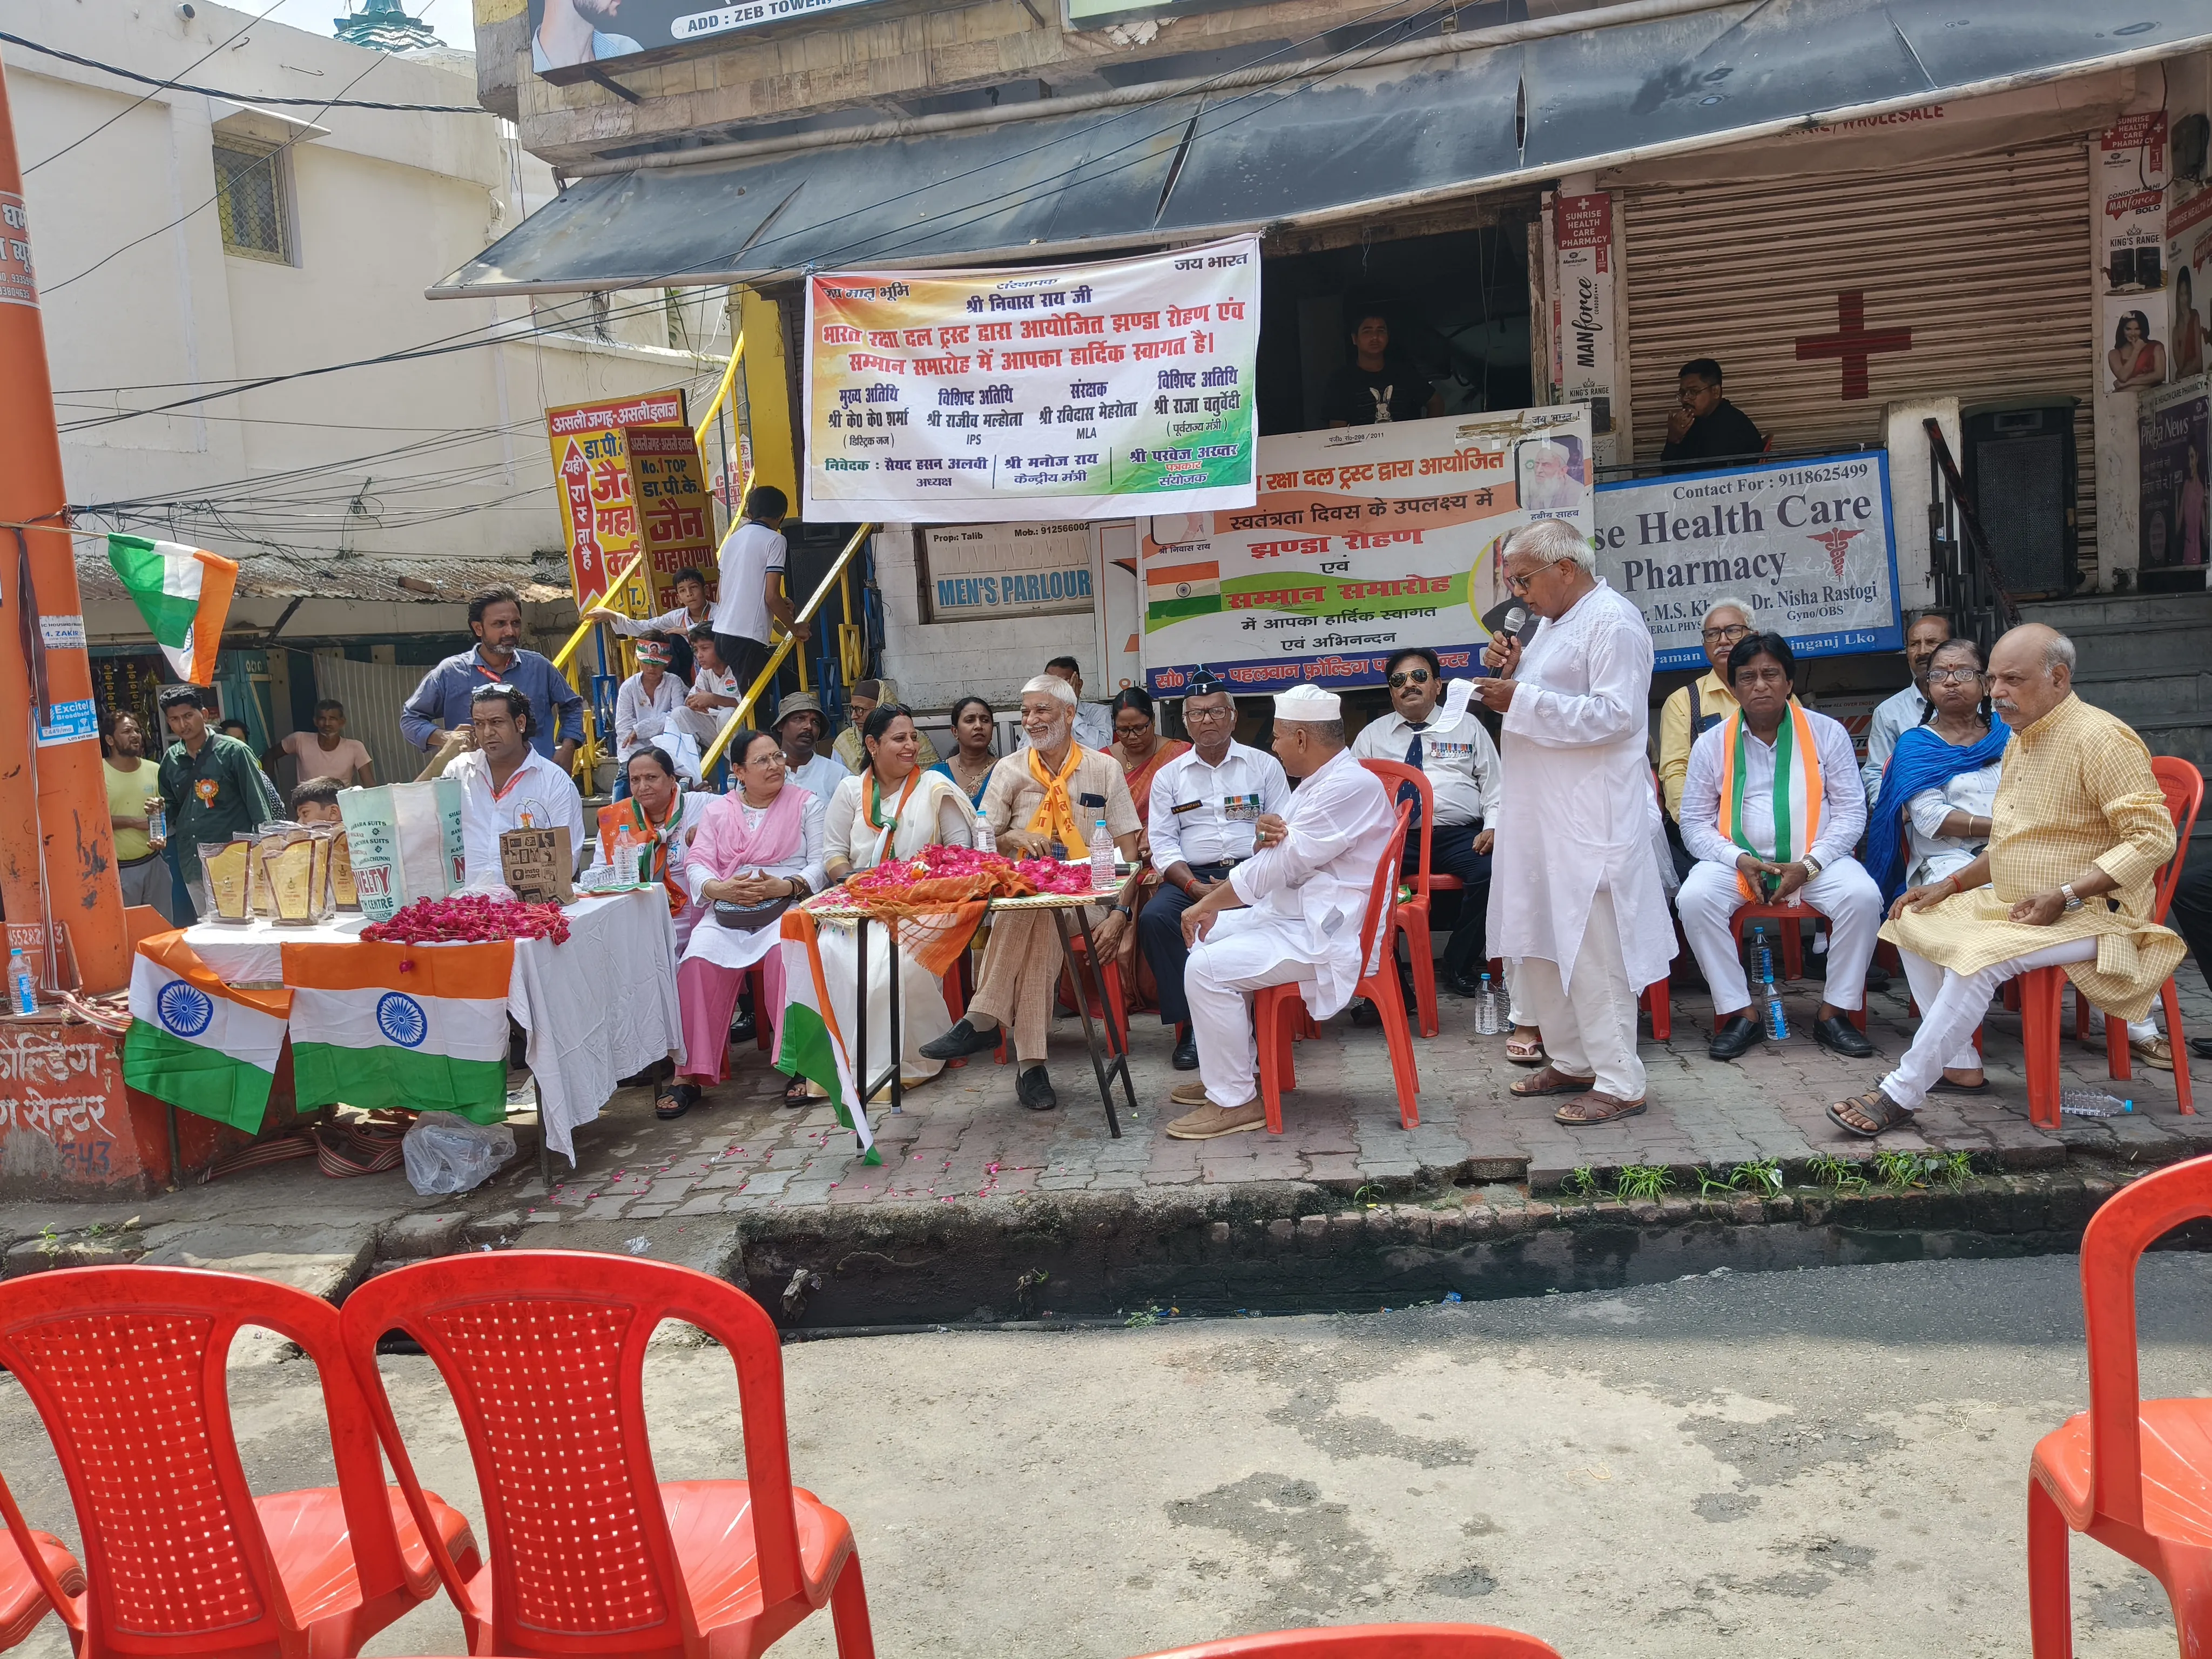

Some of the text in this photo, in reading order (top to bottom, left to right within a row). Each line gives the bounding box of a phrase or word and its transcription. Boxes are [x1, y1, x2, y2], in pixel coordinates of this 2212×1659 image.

[688, 6, 764, 32] ADD ZEB
[2117, 115, 2150, 125] SUNRISE
[2119, 123, 2148, 132] HEALTH
[2108, 188, 2140, 200] CONDOM
[1566, 210, 1602, 221] SUNRISE
[2135, 205, 2161, 215] BOLO
[1568, 219, 1600, 229] HEALTH
[1573, 228, 1595, 237] CARE
[1561, 235, 1608, 247] PHARMACY
[2110, 234, 2160, 247] KING'S RANGE
[1175, 253, 1248, 271] जय भारत
[880, 281, 910, 302] भूमि
[966, 285, 1092, 313] श्री निवास राय जी
[824, 304, 1211, 349] भारत रक्षा दल ट्रस्ट द्वारा आयोजित झण्डा रोहण
[848, 354, 907, 375] सम्मान
[912, 351, 971, 376] समारोह
[976, 348, 994, 372] में
[1001, 348, 1062, 371] आपका
[1069, 340, 1126, 366] हार्दिक
[1132, 336, 1187, 361] स्वागत
[1157, 365, 1239, 390] विशिष्ट अतिथि
[839, 382, 900, 410] मुख्य अतिथि
[938, 383, 1014, 406] विशिष्ट अतिथि
[1569, 386, 1609, 397] KING'S RANGE
[1154, 389, 1241, 417] श्री राजा चतुर्वेदी
[552, 409, 587, 433] असली
[828, 407, 909, 428] श्री शर्मा
[927, 410, 942, 427] श्री
[946, 410, 978, 428] राजीव
[1038, 404, 1095, 425] श्री रविदास
[1076, 427, 1097, 440] MLA
[2164, 415, 2189, 441] News
[966, 434, 982, 446] IPS
[824, 456, 989, 471] निवेदक सैयद हसन अलवी
[1004, 453, 1100, 470] श्री मनोज राय
[1129, 448, 1148, 463] श्री
[1151, 446, 1192, 462] परवेज
[565, 455, 584, 476] यही
[665, 459, 687, 473] TOP
[1165, 460, 1203, 472] पत्रकार
[1266, 447, 1505, 490] रक्षा दल ट्रस्ट द्वारा आयोजित
[916, 477, 953, 487] अध्यक्ष
[1061, 469, 1088, 482] मंत्री
[1158, 472, 1209, 487] संयोजक
[1673, 463, 1868, 501] Contact For 9118625499
[1229, 487, 1494, 531] स्वतंत्रता दिवस के उपलक्ष्य में
[1555, 509, 1580, 519] साहब
[645, 496, 705, 543] जैन
[1636, 494, 1872, 546] Health Care
[961, 531, 983, 541] Talib
[1247, 528, 1426, 559] झण्डा रोहण
[1158, 542, 1211, 555] श्री निवास राय
[1319, 554, 1351, 575] एवं
[1622, 551, 1787, 593] Pharmacy
[937, 569, 1092, 606] MEN'S PARLOUR
[1225, 574, 1452, 609] सम्मान समारोह
[1751, 581, 1878, 611] Dr. Nisha Rastogi
[1241, 606, 1438, 631] में आपका हार्दिक स्वागत
[1654, 603, 1687, 621] M.S.
[1786, 605, 1844, 622] Gyno/OBS
[1280, 632, 1397, 651] एवं अभिनन्दन
[1844, 632, 1876, 645] Lko
[1229, 663, 1301, 684] पहलवान
[55, 700, 89, 714] Excitel
[56, 710, 90, 720] Broadband
[368, 896, 394, 910] CENTRE
